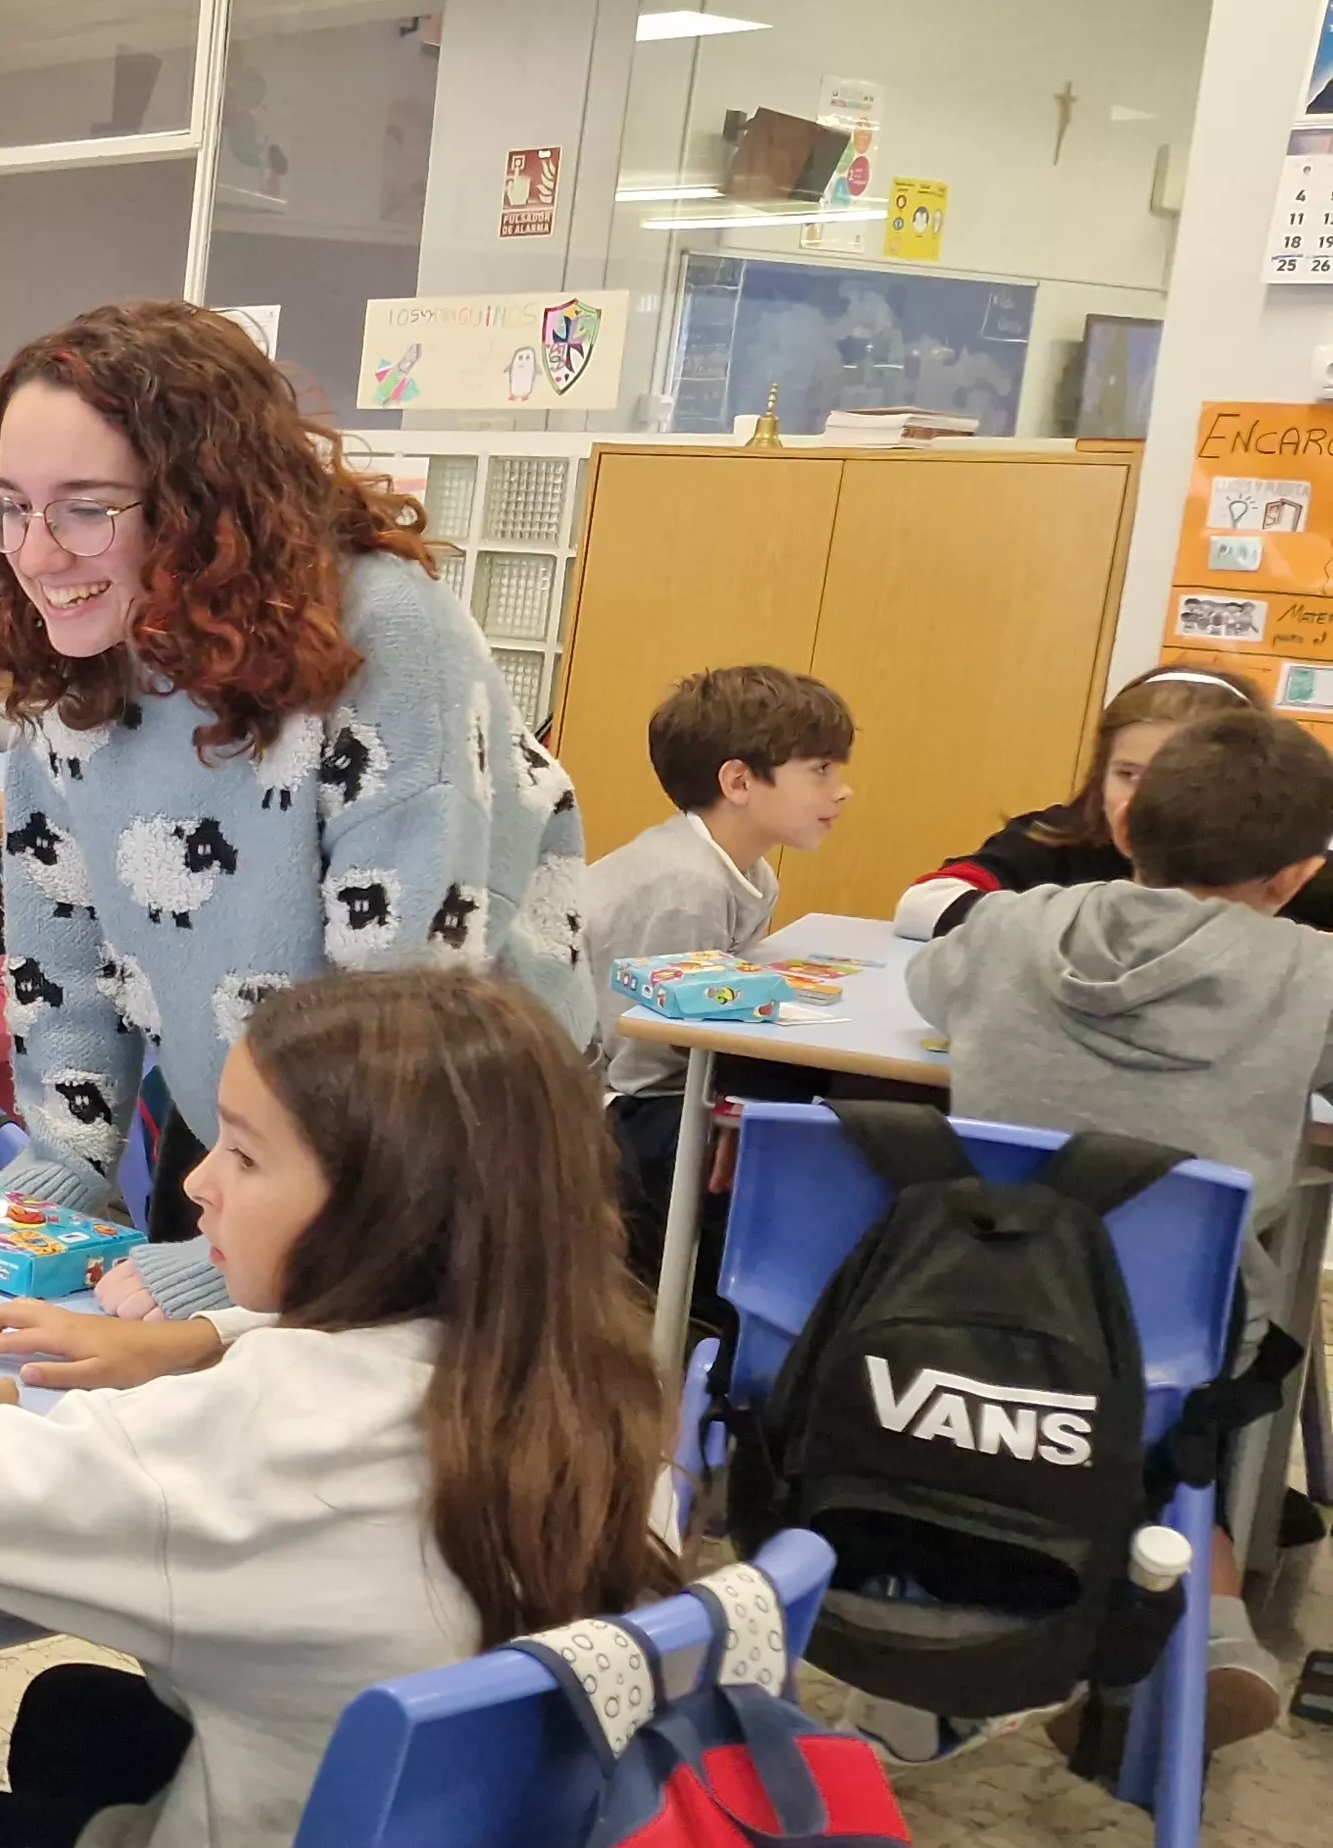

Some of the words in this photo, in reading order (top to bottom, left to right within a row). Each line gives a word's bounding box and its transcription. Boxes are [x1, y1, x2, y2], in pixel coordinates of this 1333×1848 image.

[1295, 189, 1306, 202] 4
[503, 211, 551, 225] PULSADOR
[1289, 213, 1304, 225] 11
[501, 225, 513, 235] DE
[514, 223, 550, 235] ALARMA
[1284, 236, 1302, 249] 18
[1276, 259, 1297, 272] 25
[1311, 259, 1331, 272] 26
[865, 1354, 1099, 1466] VANS
